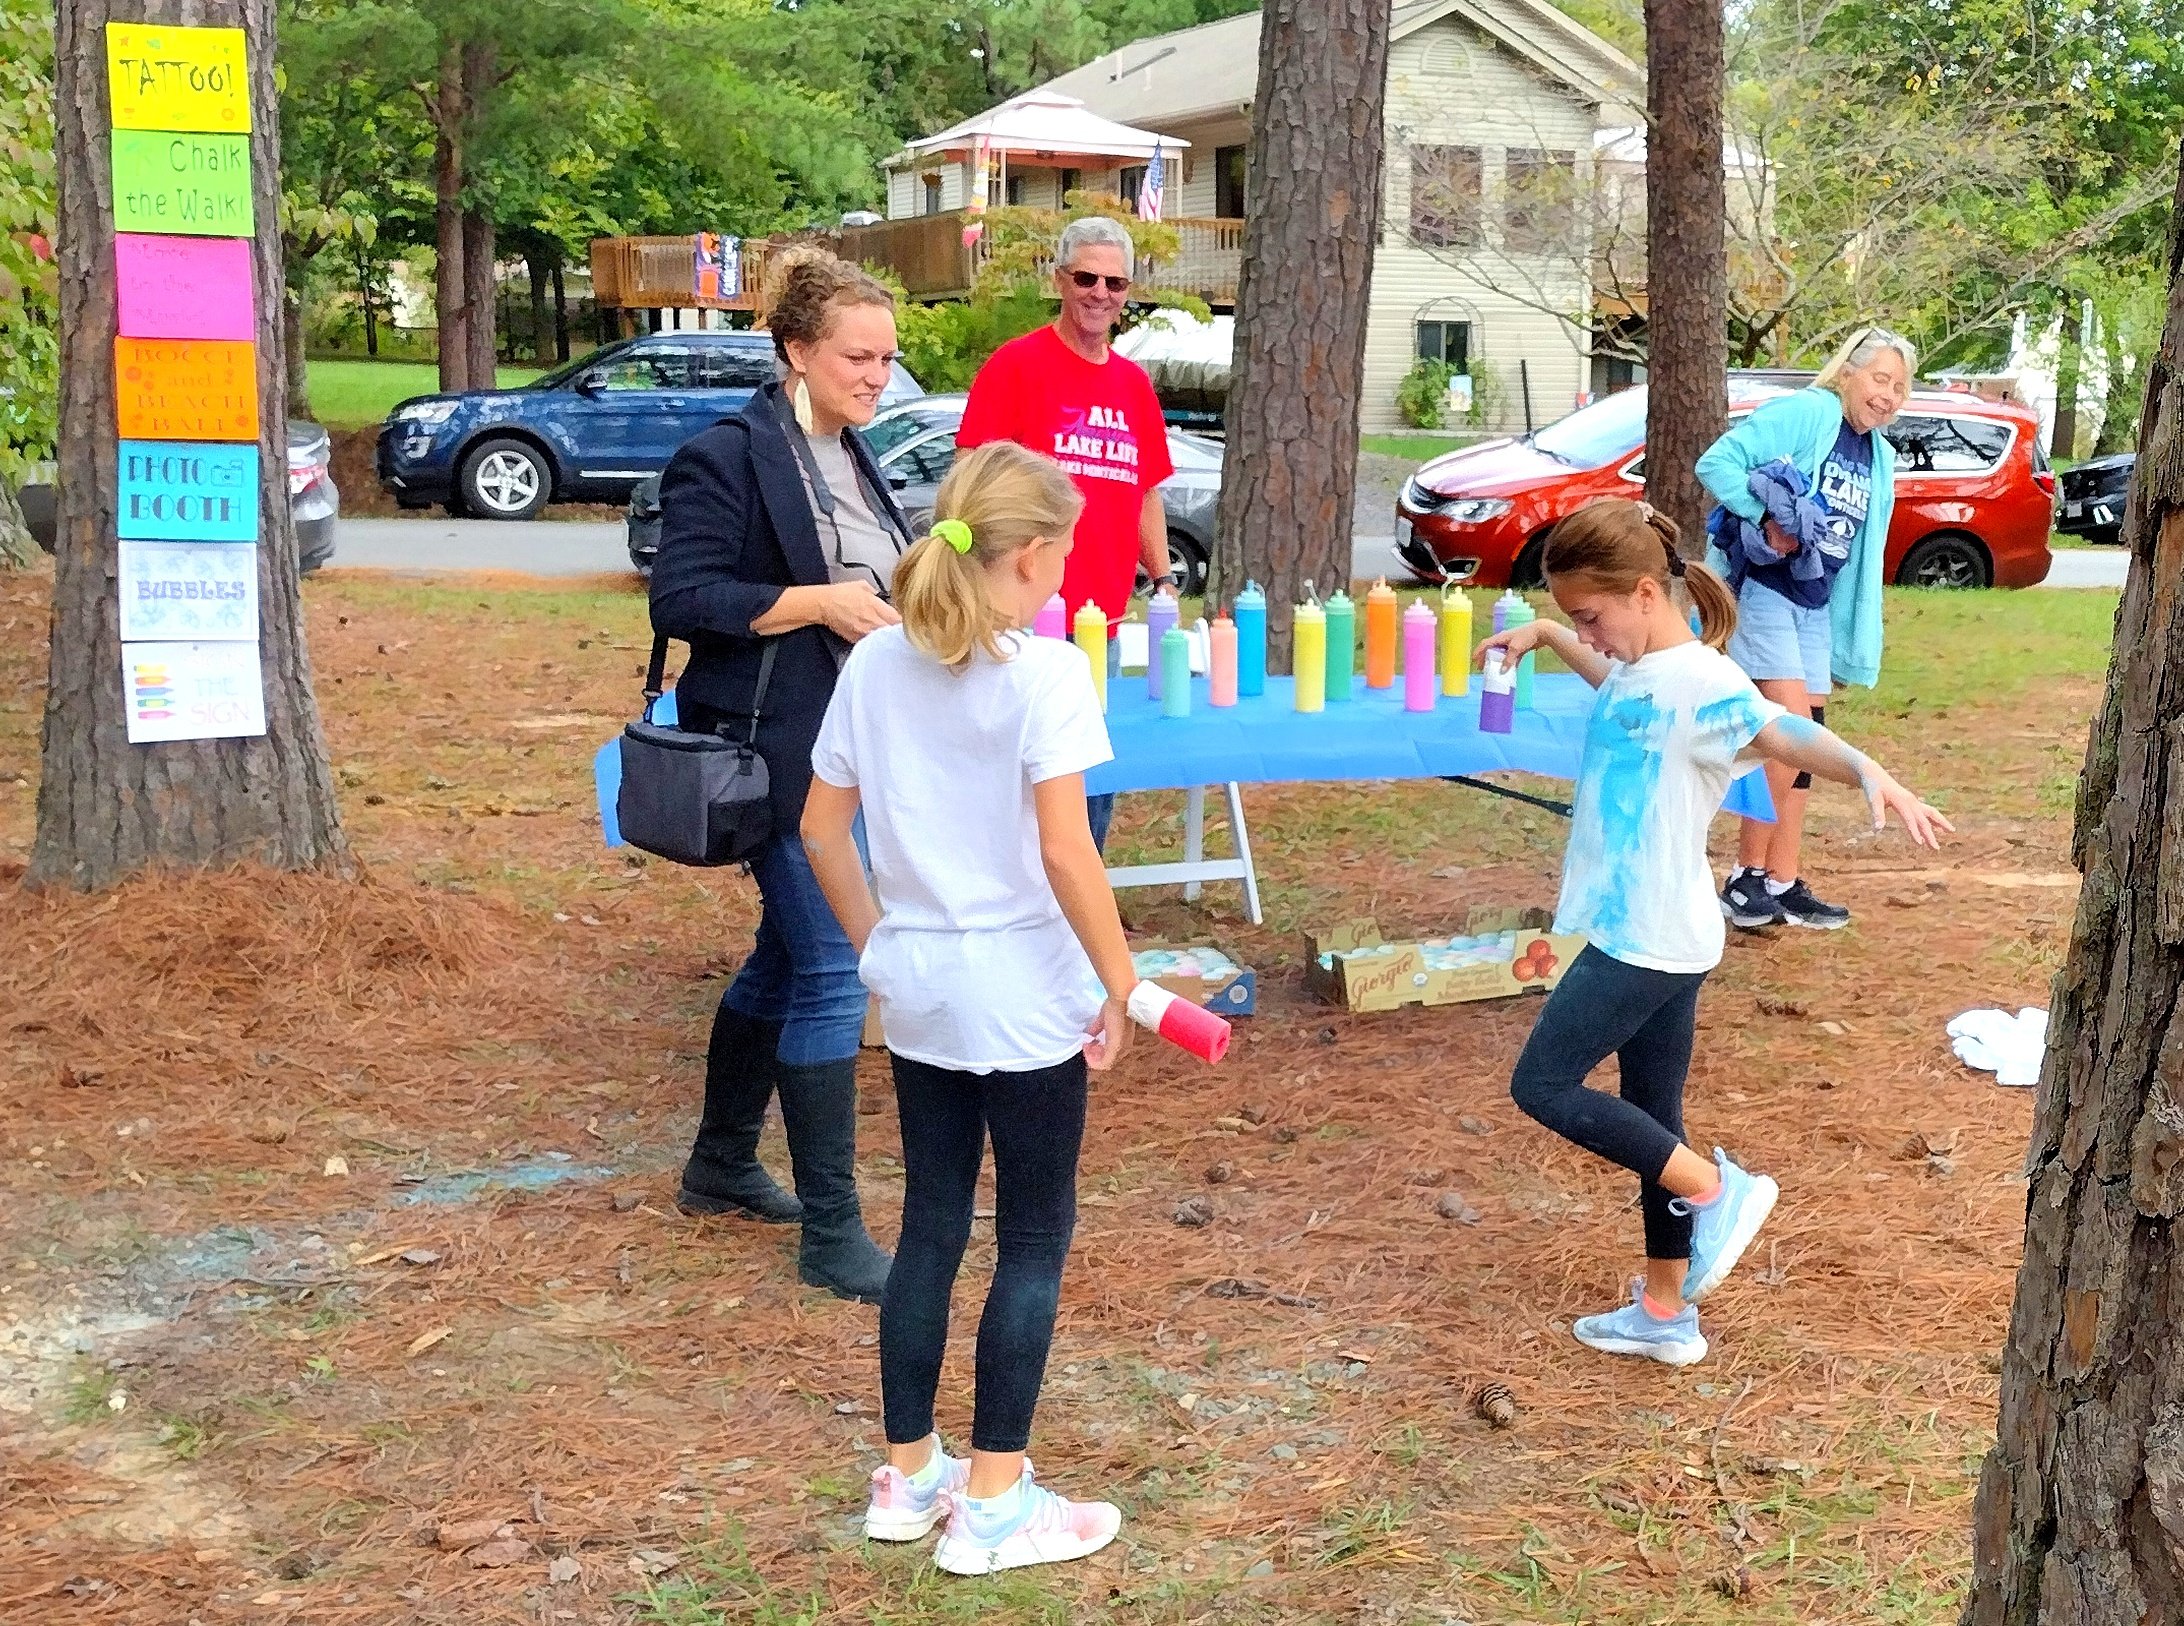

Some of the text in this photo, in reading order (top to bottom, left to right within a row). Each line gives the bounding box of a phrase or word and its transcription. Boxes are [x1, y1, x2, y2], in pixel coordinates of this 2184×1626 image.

[118, 59, 234, 97] TATTOO!
[169, 140, 242, 173] Chalk
[126, 187, 246, 223] the Walk!
[1087, 405, 1130, 433] ALL
[1054, 432, 1104, 459] LAKE
[128, 455, 207, 485] PHOTO
[130, 493, 242, 522] BOOTH
[1820, 476, 1870, 512] LAKE
[137, 580, 246, 601] BUBBLES
[190, 700, 250, 725] SIGN
